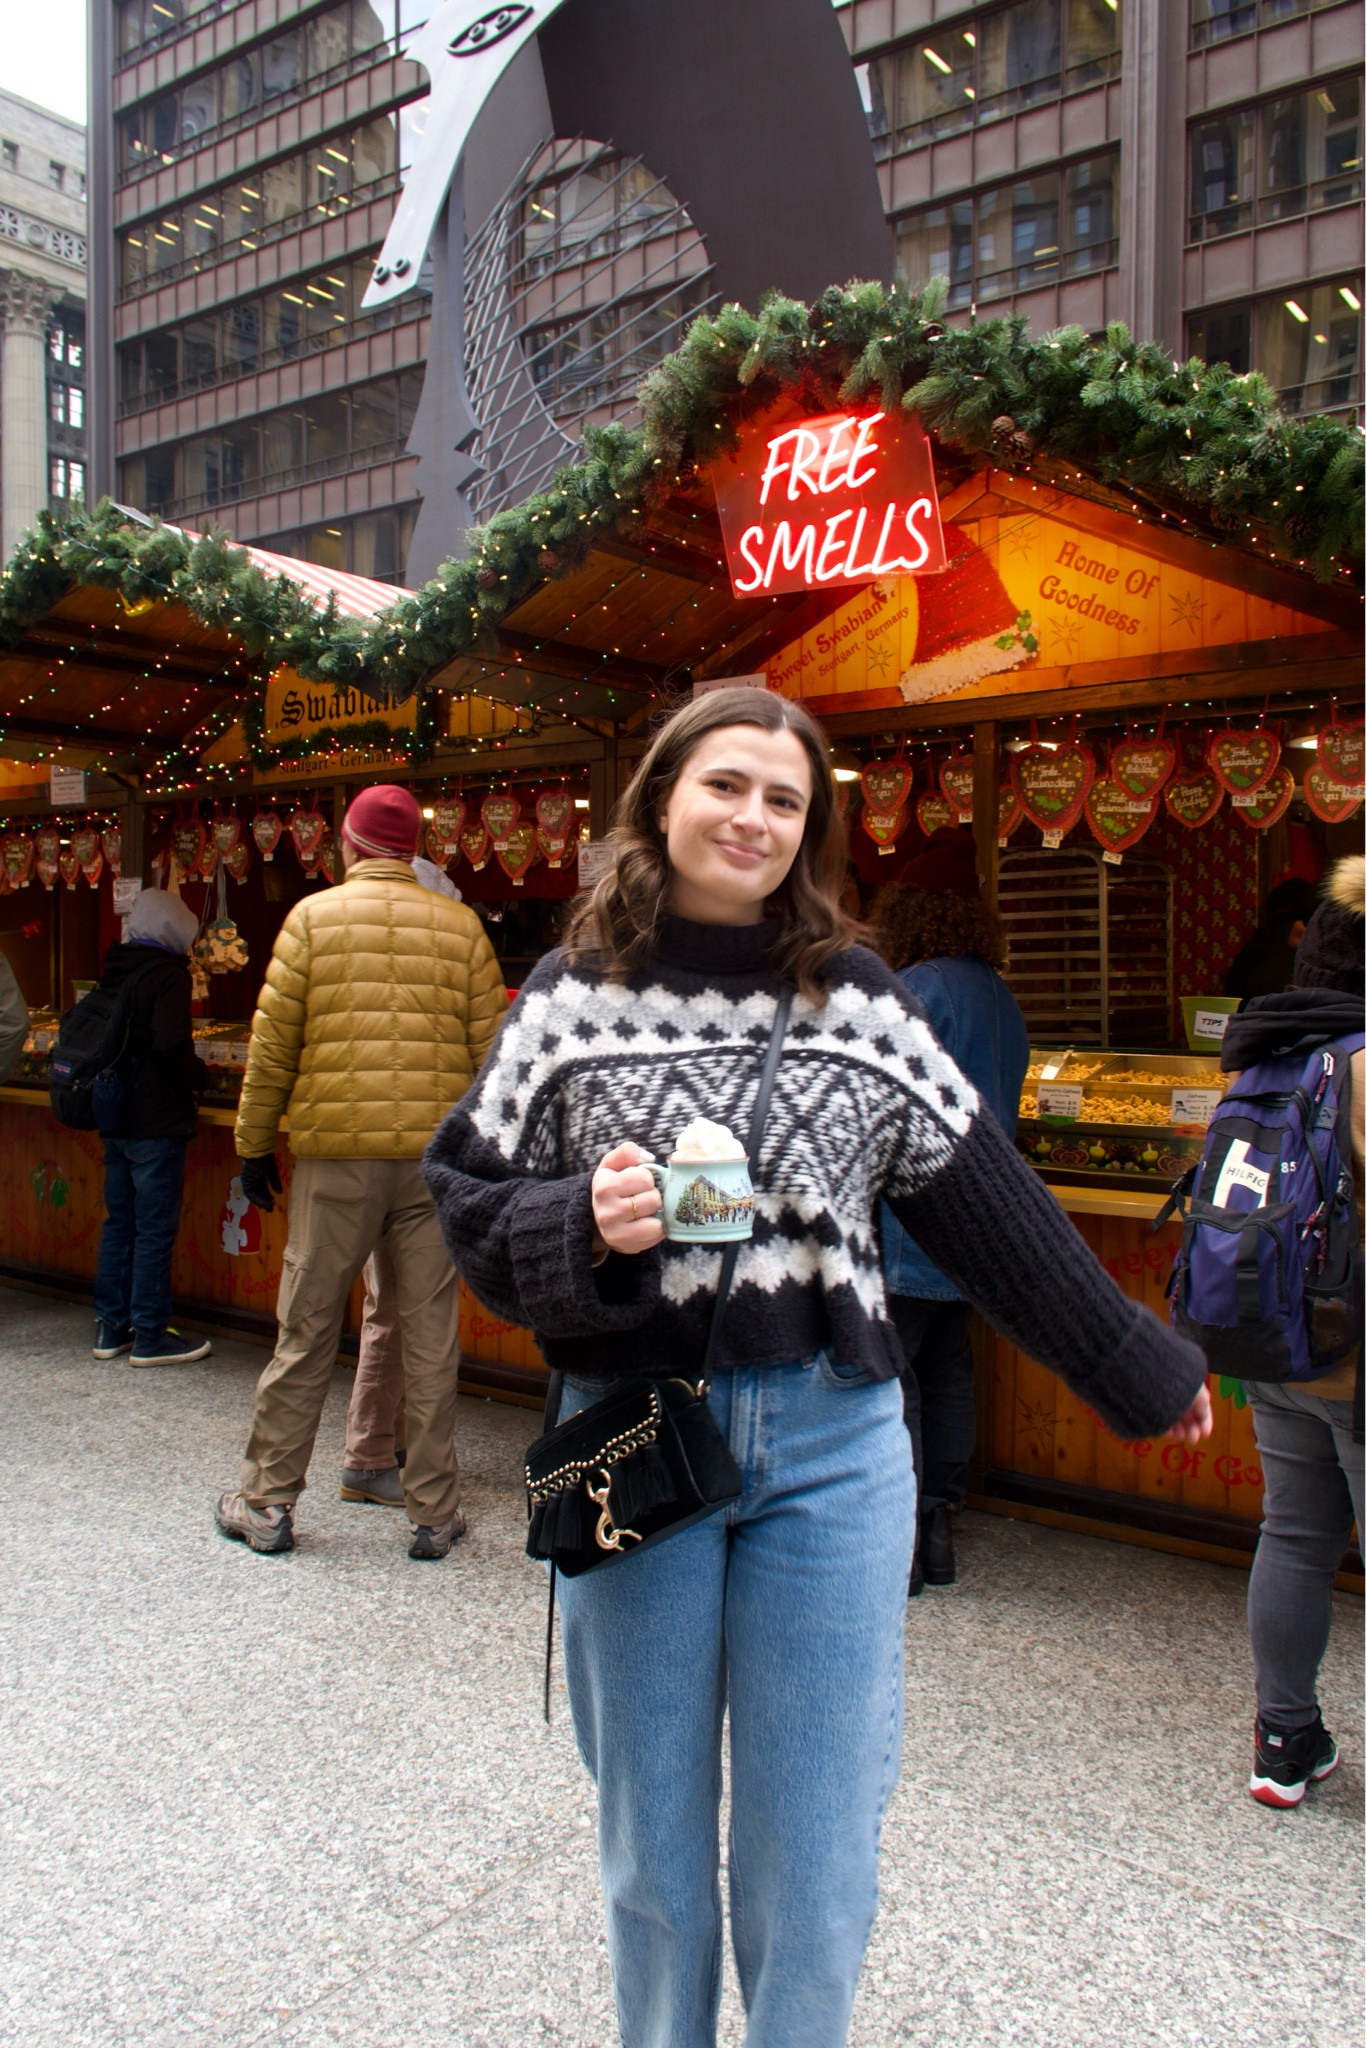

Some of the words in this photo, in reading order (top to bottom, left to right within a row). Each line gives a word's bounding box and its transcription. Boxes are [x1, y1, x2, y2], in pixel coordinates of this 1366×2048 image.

[759, 412, 885, 505] FREE
[735, 498, 932, 591] SMELLS
[1055, 540, 1120, 584] Home
[1125, 569, 1161, 600] Of
[1039, 575, 1141, 635] Goodness
[769, 650, 817, 689] Sweet
[816, 604, 887, 654] Swabian
[818, 643, 860, 677] Stuttgart
[865, 607, 909, 642] Germany
[1202, 1018, 1223, 1027] TIPS
[1280, 1161, 1297, 1174] 85
[1161, 1443, 1206, 1479] Of
